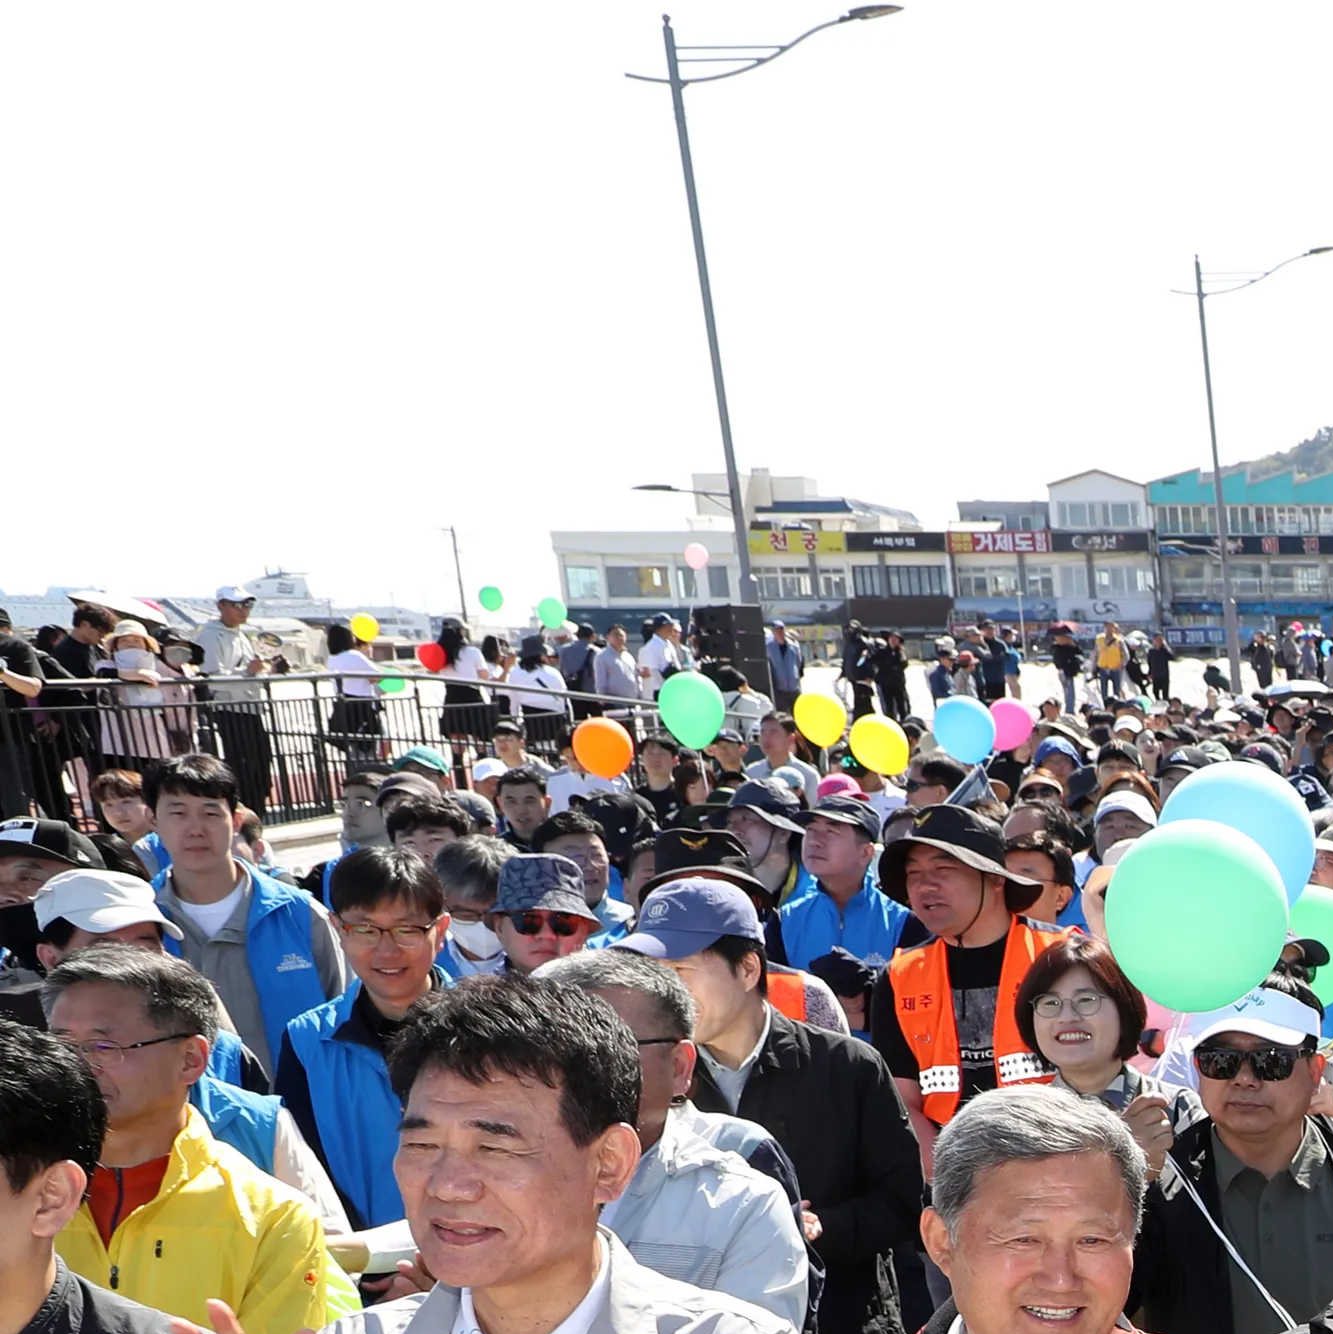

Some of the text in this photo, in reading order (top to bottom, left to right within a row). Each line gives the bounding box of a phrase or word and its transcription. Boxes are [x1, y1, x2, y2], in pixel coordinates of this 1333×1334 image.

[973, 532, 1034, 552] 거제도
[900, 994, 933, 1012] 제주
[961, 1049, 994, 1060] RTIC
